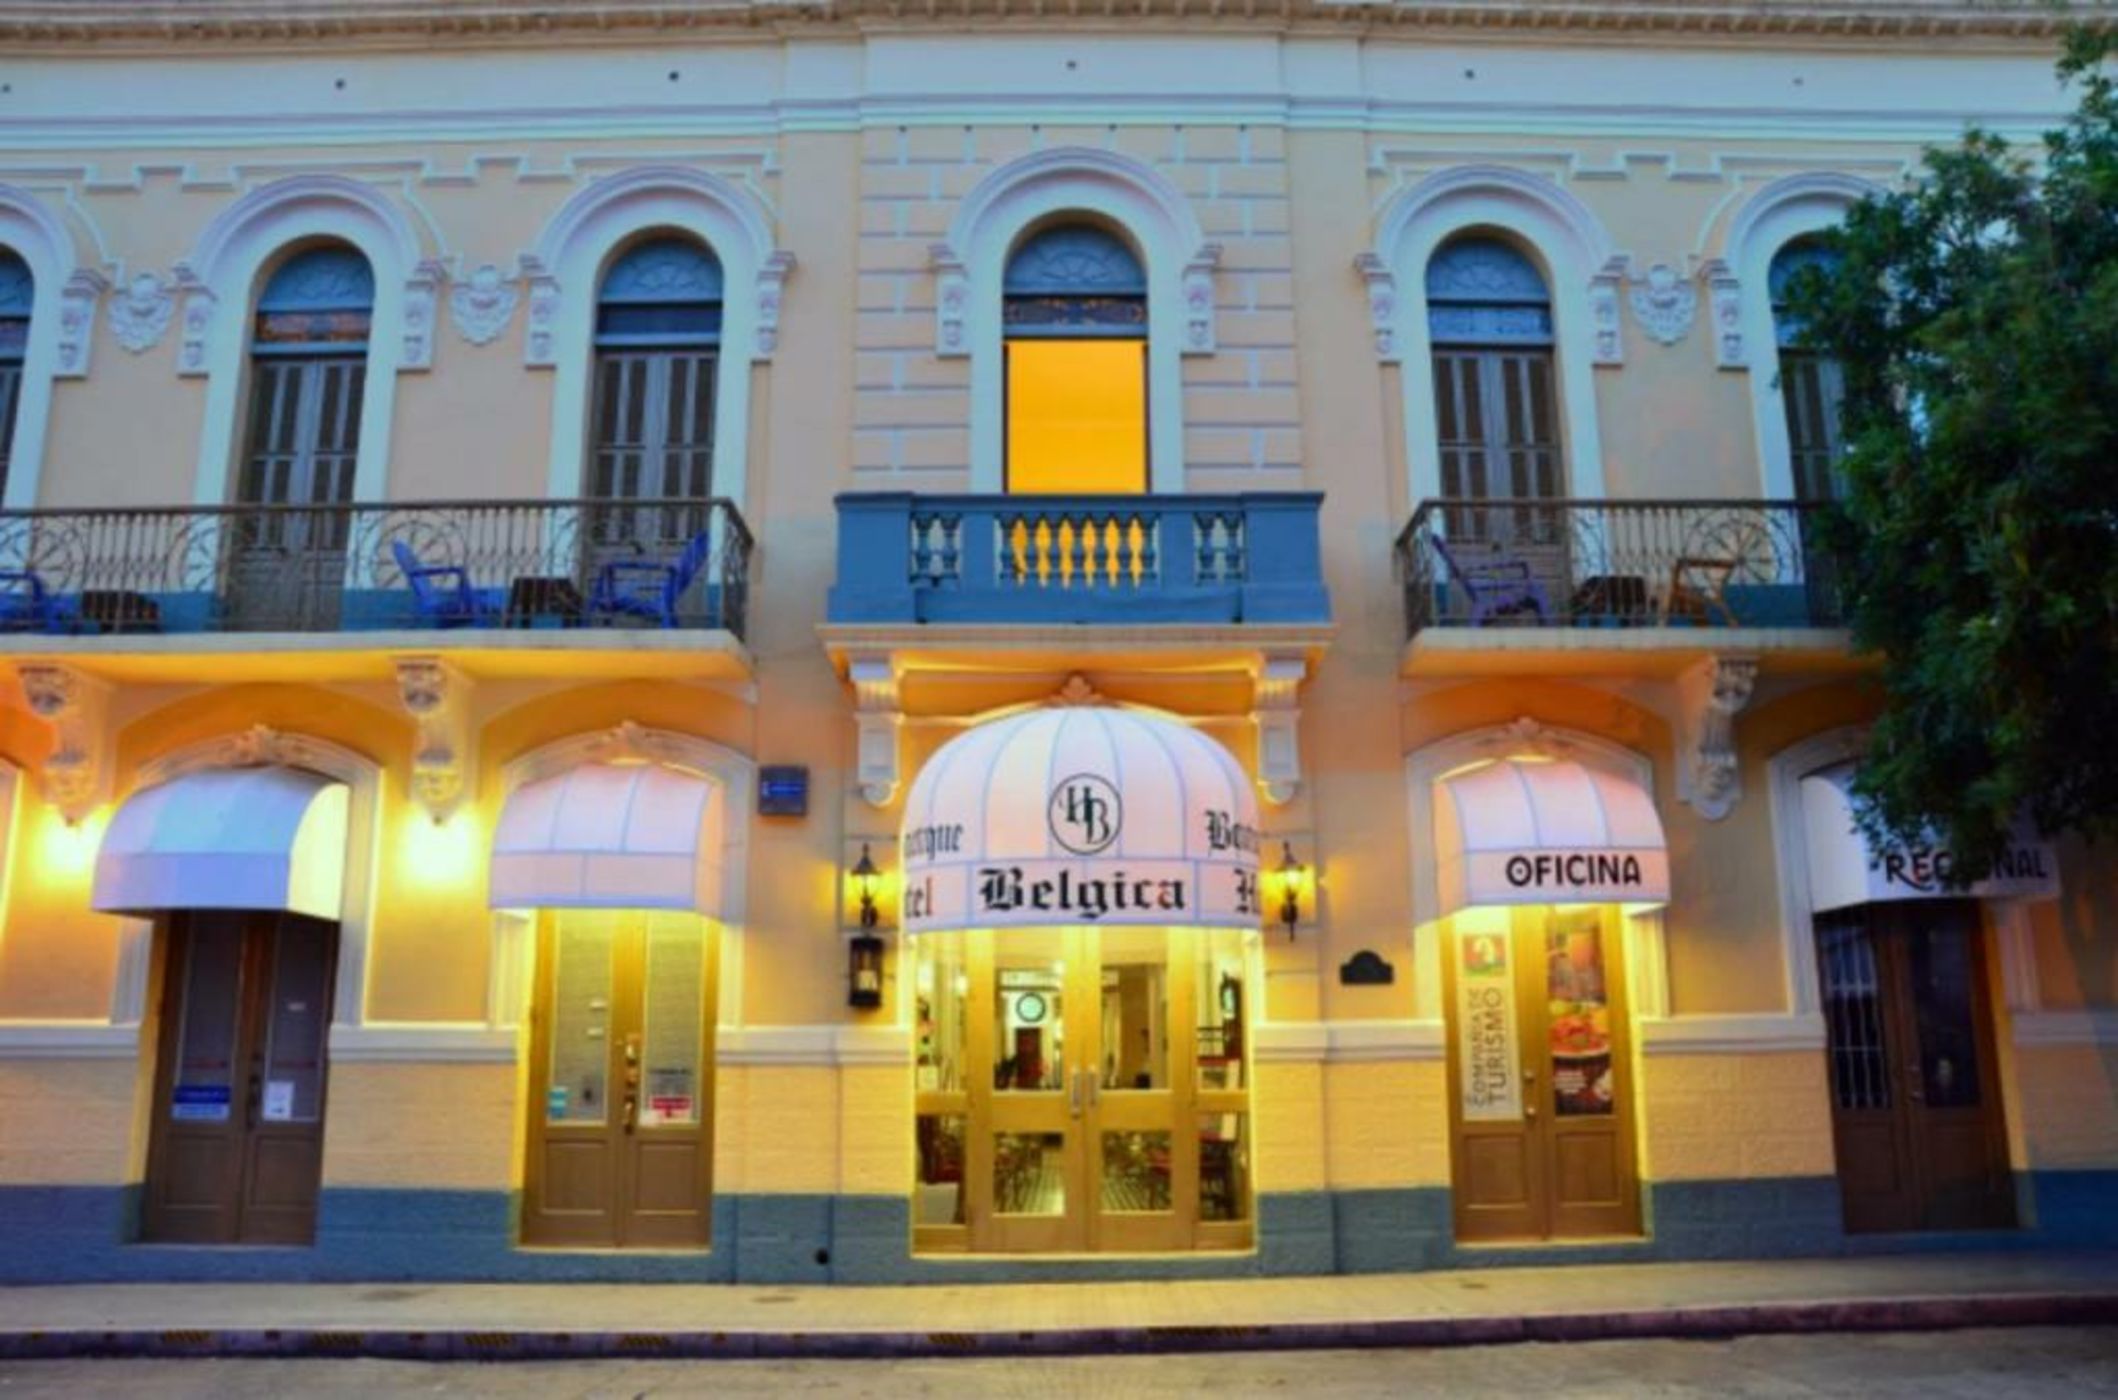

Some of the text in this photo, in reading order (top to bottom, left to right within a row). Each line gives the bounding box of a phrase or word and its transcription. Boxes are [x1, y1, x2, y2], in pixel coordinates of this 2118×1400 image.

[978, 868, 1186, 919] Belgica
[1506, 855, 1641, 886] OFICINA
[1482, 987, 1507, 1105] TURISMO
